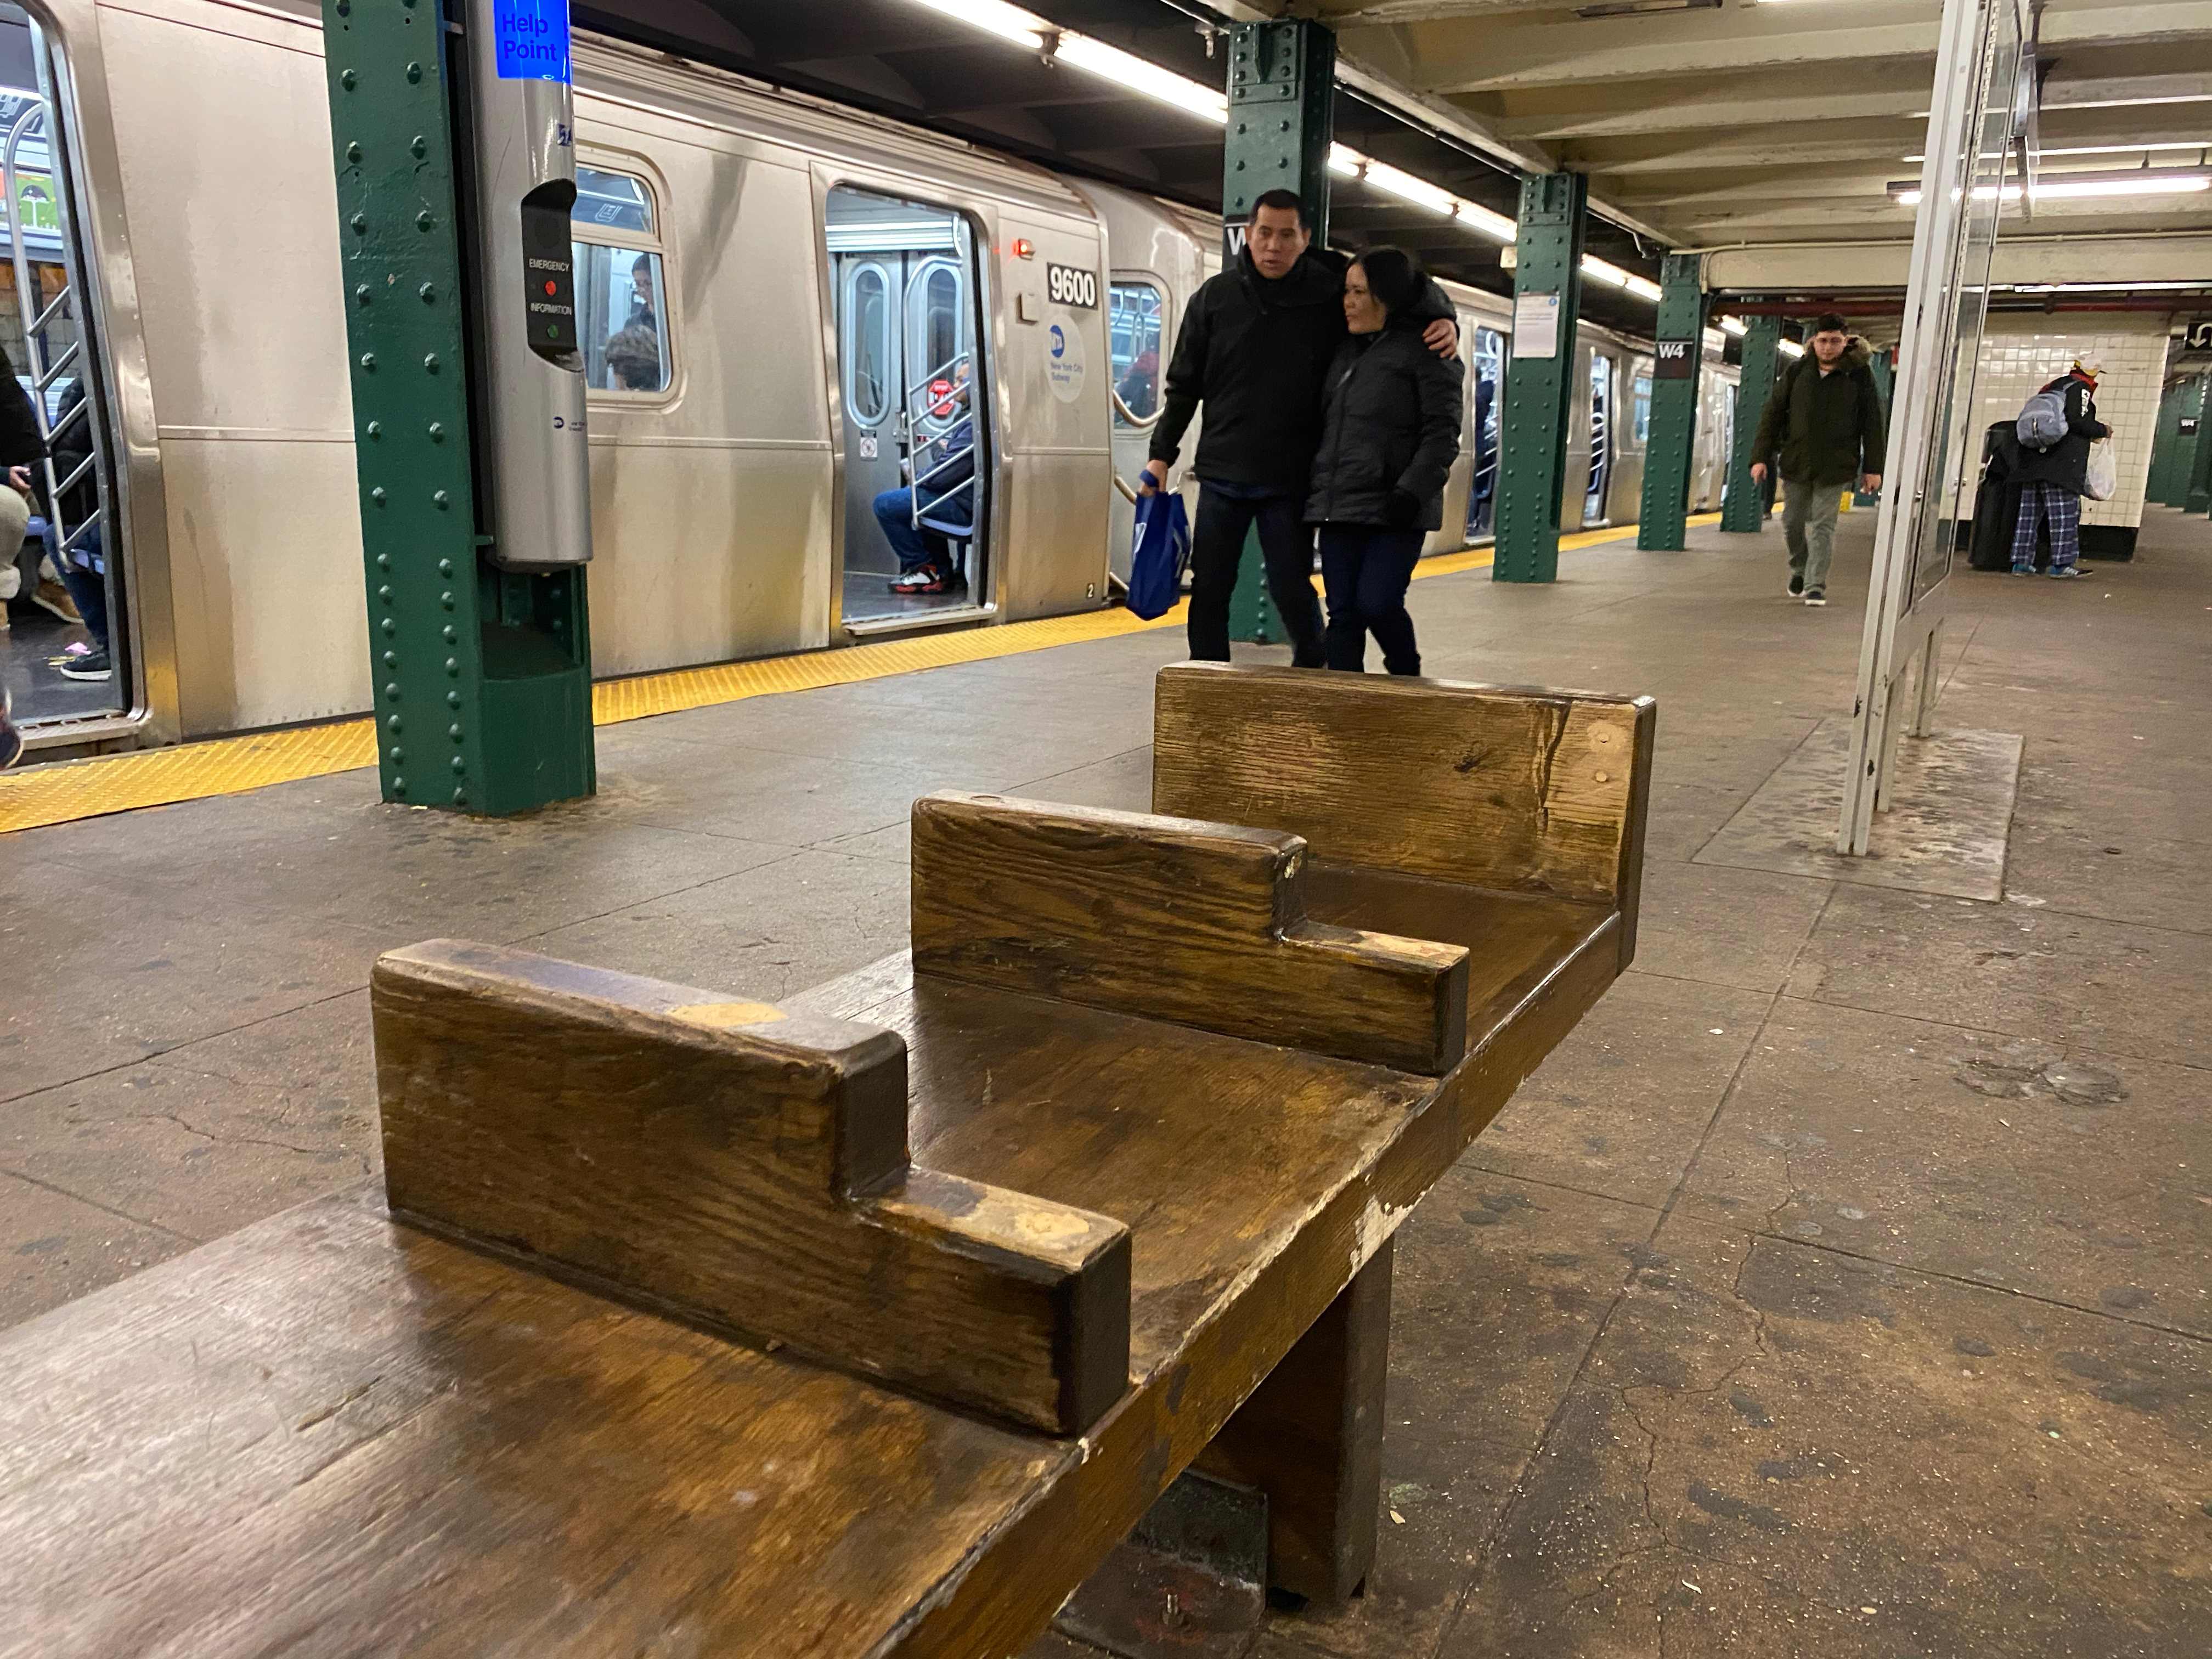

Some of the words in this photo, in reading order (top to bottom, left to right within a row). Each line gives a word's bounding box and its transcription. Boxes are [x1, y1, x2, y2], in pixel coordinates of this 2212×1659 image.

[502, 13, 548, 37] Help
[504, 40, 557, 61] Point
[1227, 227, 1246, 255] W
[529, 257, 569, 272] EMERGENCY
[1050, 266, 1096, 307] 9600
[531, 302, 572, 315] INFORMATION
[1659, 345, 1685, 358] W4
[1087, 584, 1094, 598] 2
